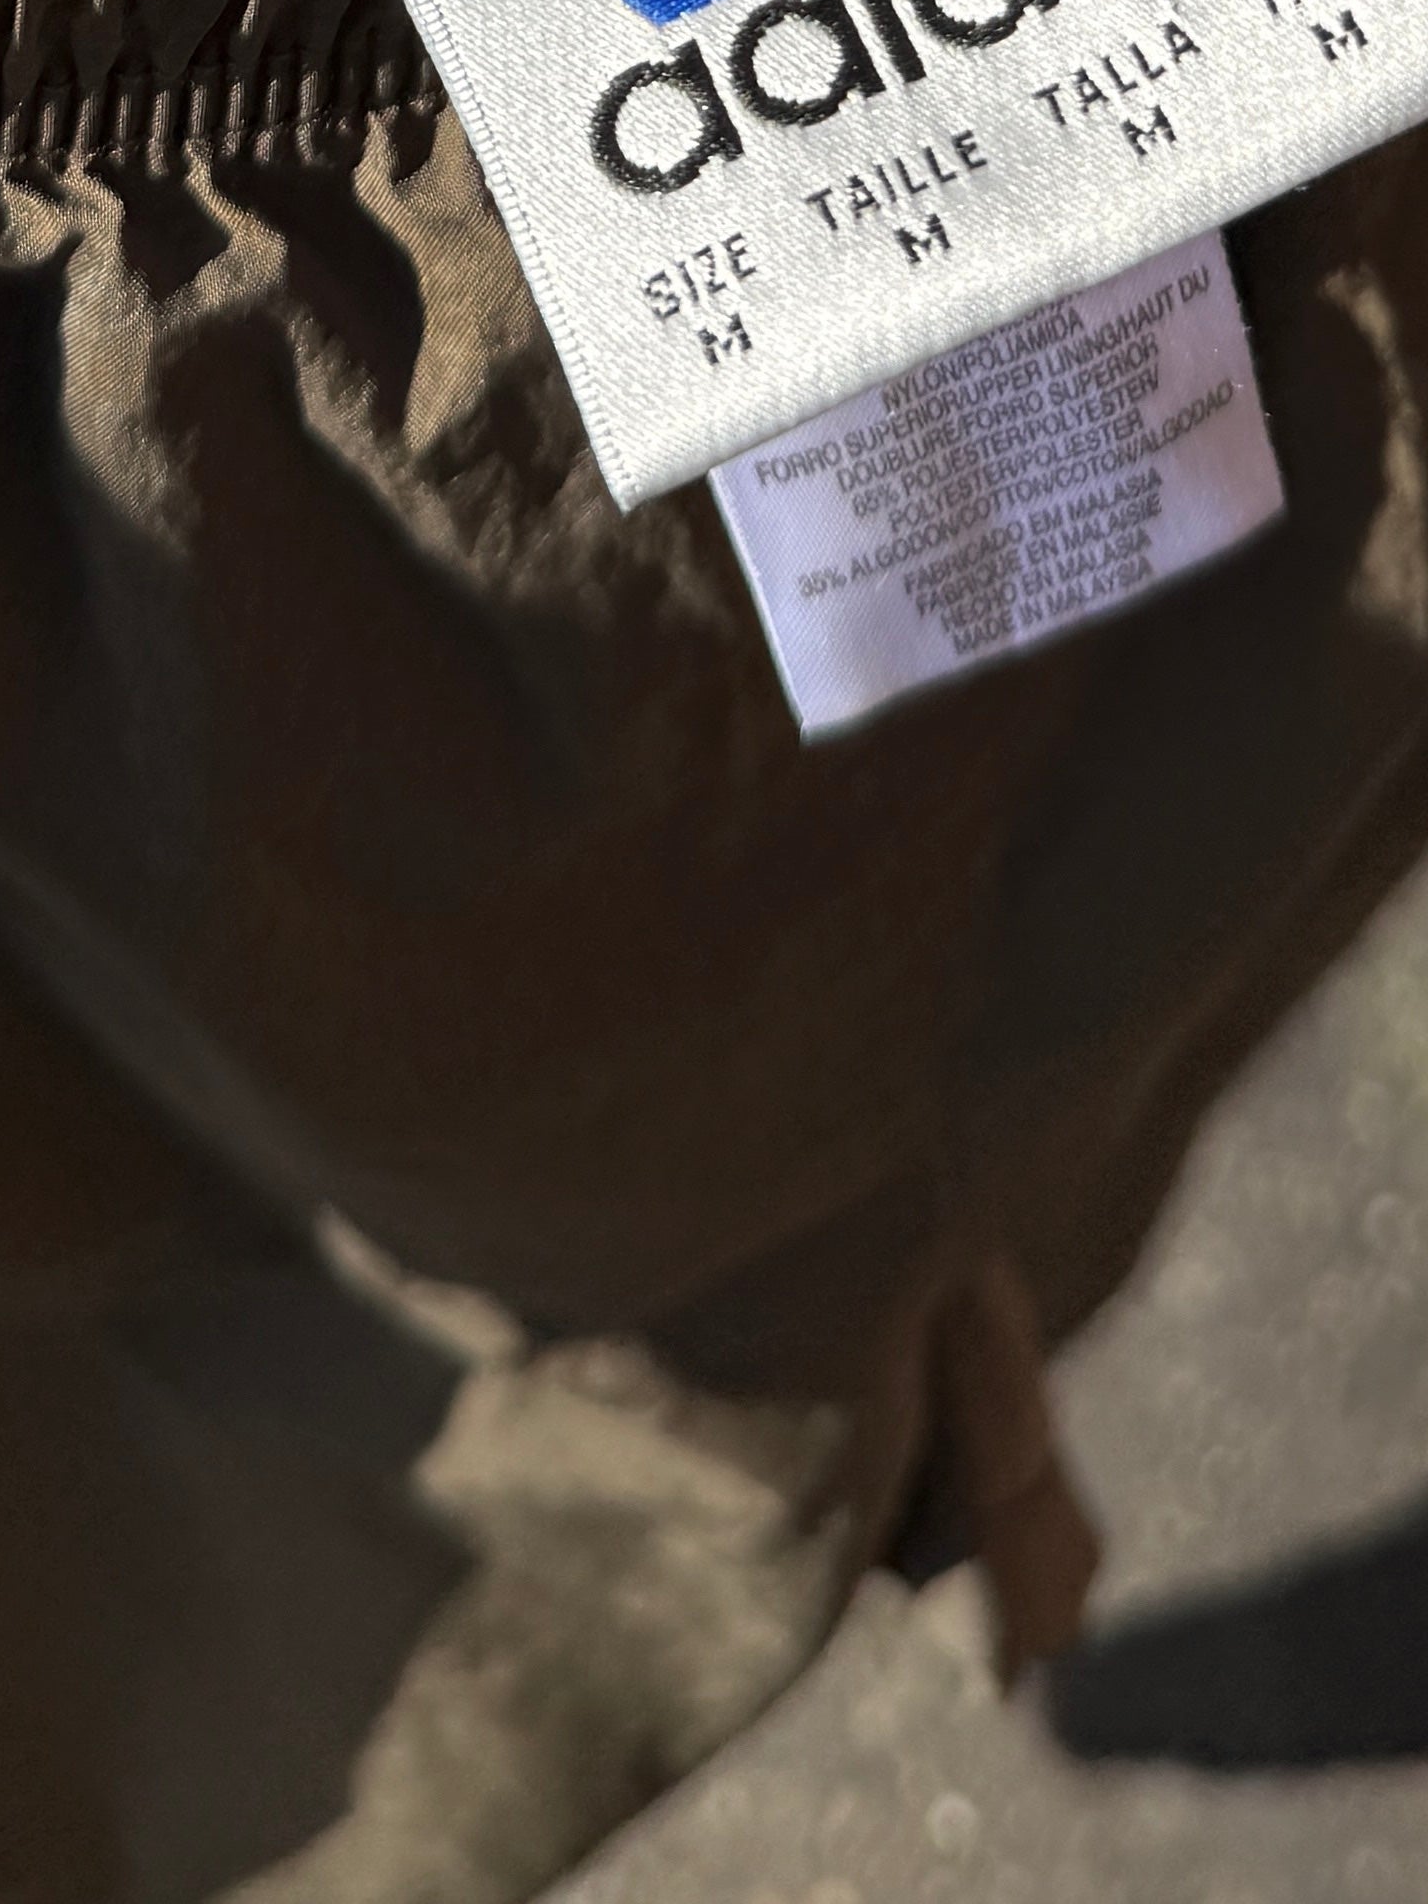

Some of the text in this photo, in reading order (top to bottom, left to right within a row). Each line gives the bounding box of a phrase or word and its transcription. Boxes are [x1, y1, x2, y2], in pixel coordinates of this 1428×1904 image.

[643, 232, 757, 319] SIZE
[806, 129, 987, 230] TAILLE
[1035, 21, 1201, 125] TALLA
[698, 9, 1368, 365] M M M M
[756, 441, 841, 486] FORRO
[846, 361, 1040, 456] SUPERIOR/UPPER
[1179, 266, 1211, 301] DU
[838, 332, 1157, 490] DOUBLURE/FORRO SUPERIOR
[1027, 535, 1056, 563] EN
[1030, 504, 1061, 533] EM
[1068, 466, 1160, 519] MALASIA
[954, 612, 1013, 653] MADE
[1021, 599, 1040, 623] IN
[1023, 567, 1052, 594] EN
